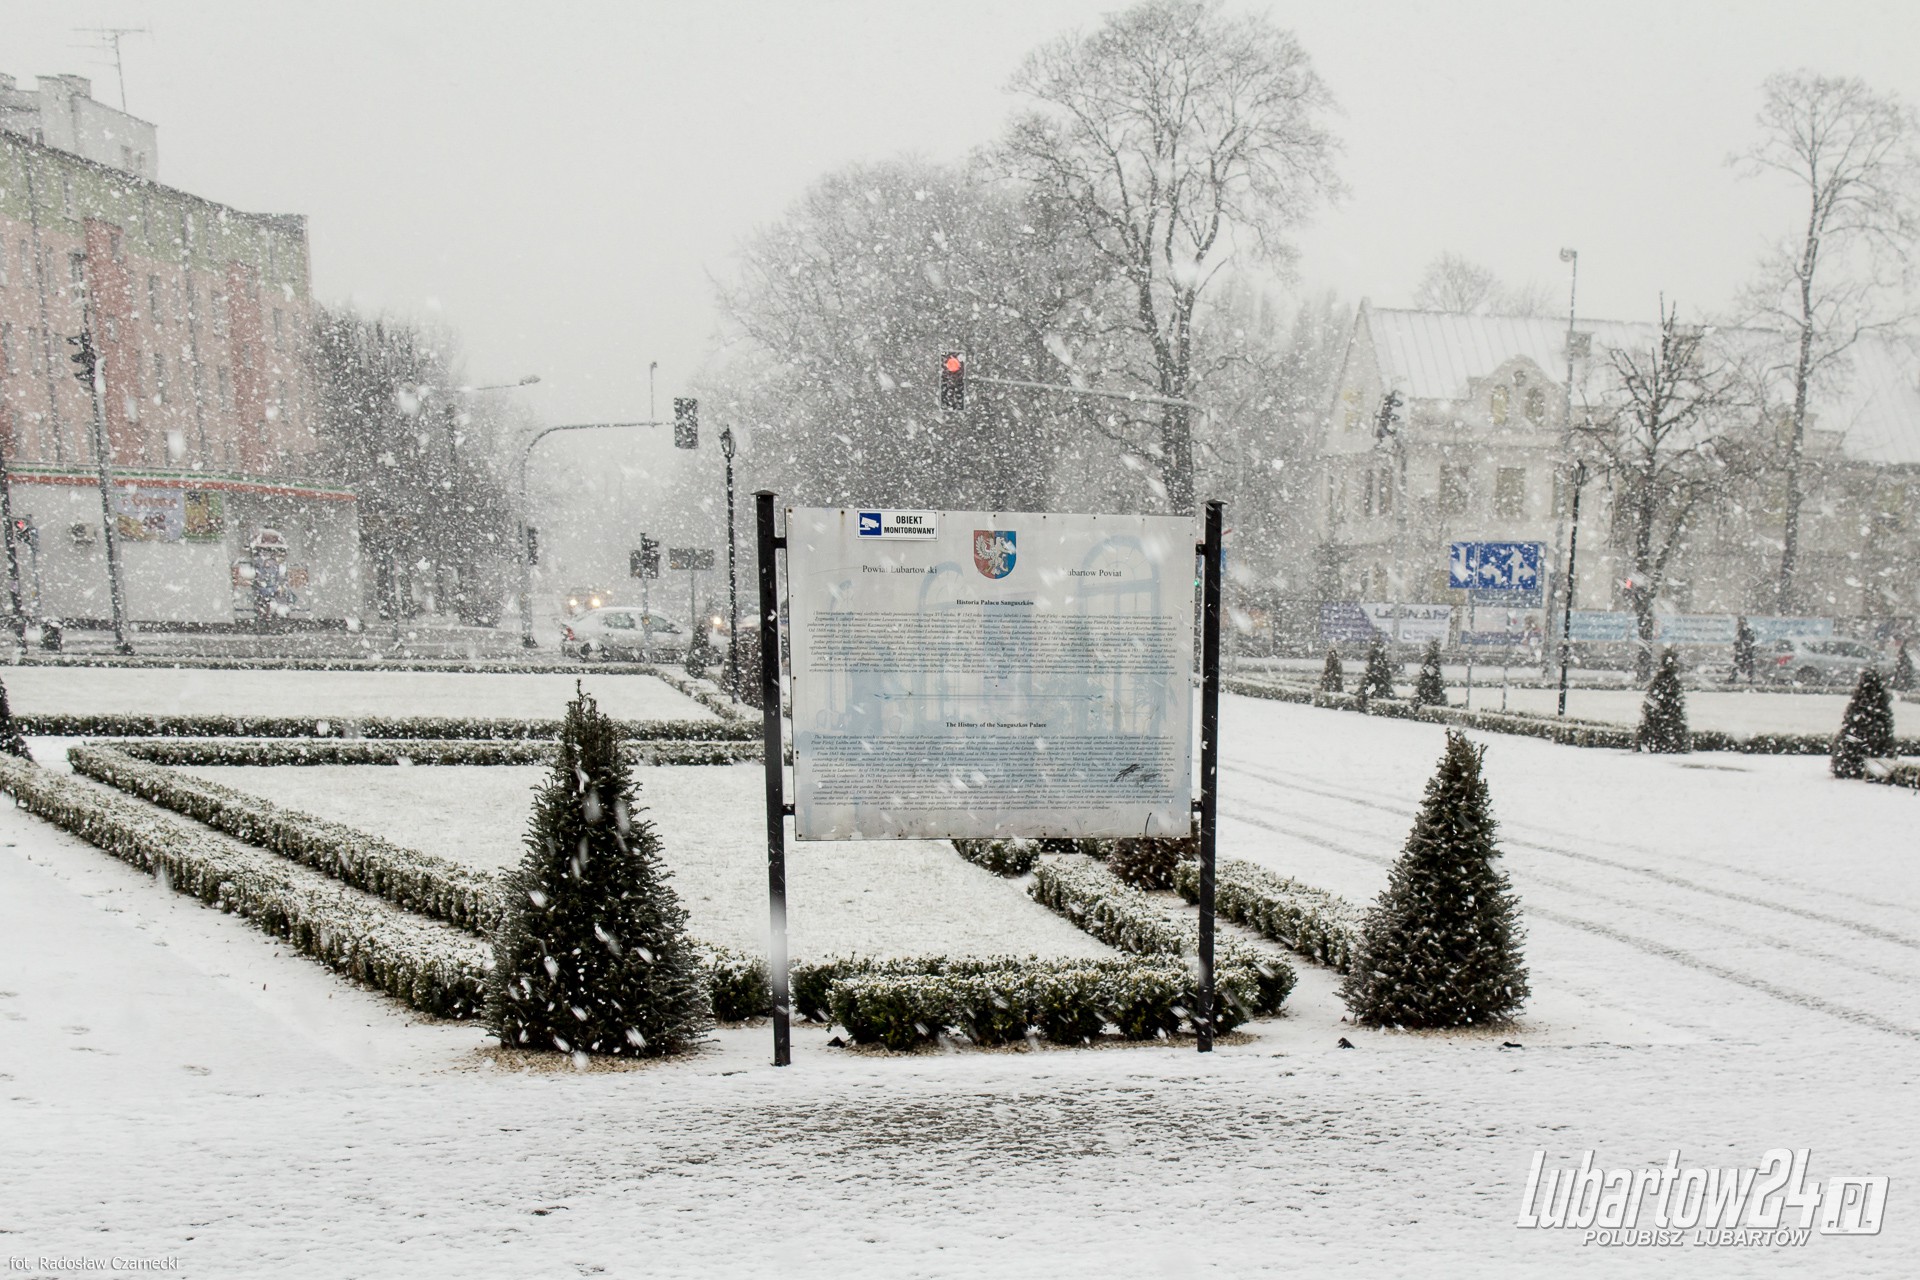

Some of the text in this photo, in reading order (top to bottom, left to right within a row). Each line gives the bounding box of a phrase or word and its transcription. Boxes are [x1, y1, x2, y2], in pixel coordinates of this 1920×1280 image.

[895, 515, 923, 525] OBIEKT
[883, 526, 935, 535] MONITOROWANY
[890, 565, 937, 574] Lubartowki
[1063, 568, 1122, 577] ubartow Poviat
